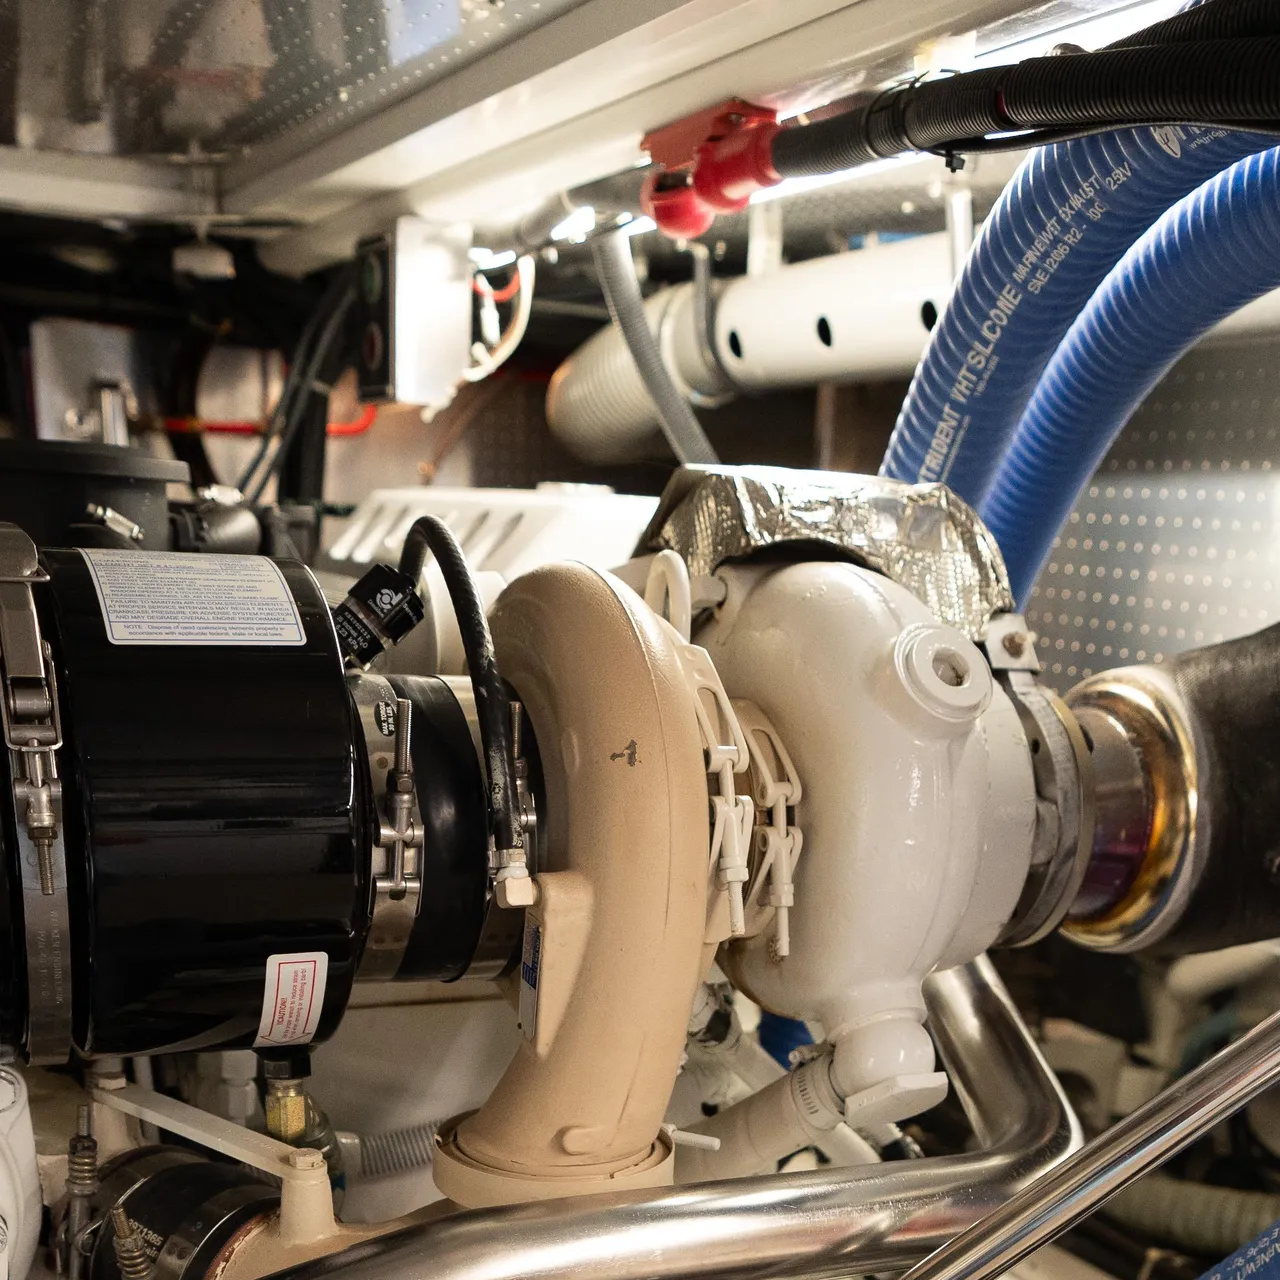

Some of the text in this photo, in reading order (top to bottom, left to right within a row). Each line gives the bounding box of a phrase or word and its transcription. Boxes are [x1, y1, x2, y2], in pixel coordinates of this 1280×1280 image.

[1064, 227, 1083, 246] R2
[920, 403, 960, 481] TRIDENT
[950, 361, 978, 404] VHT
